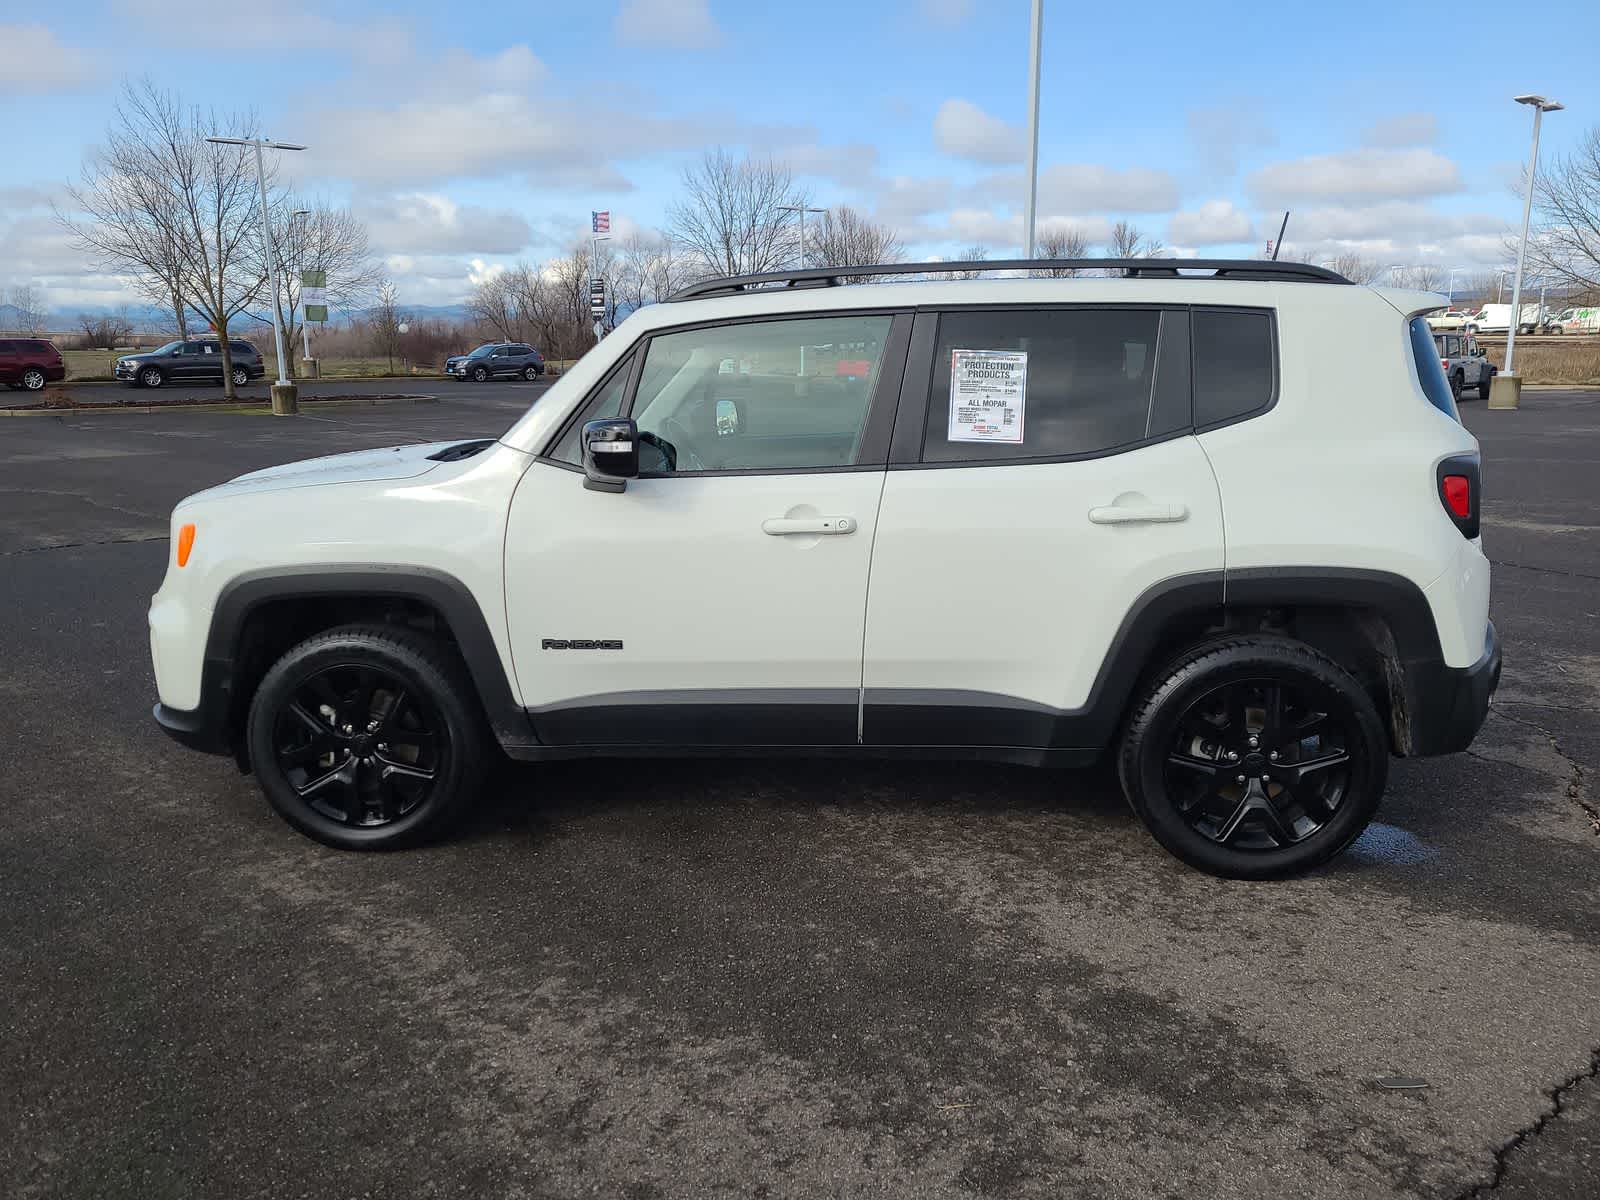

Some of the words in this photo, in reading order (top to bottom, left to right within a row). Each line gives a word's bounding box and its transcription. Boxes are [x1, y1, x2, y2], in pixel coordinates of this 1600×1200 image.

[964, 361, 1014, 370] PROTECTION
[968, 369, 1010, 379] PRODUCTS
[968, 399, 981, 407] ALL
[982, 400, 1007, 408] MOPAR
[541, 639, 623, 650] RENEGADE
